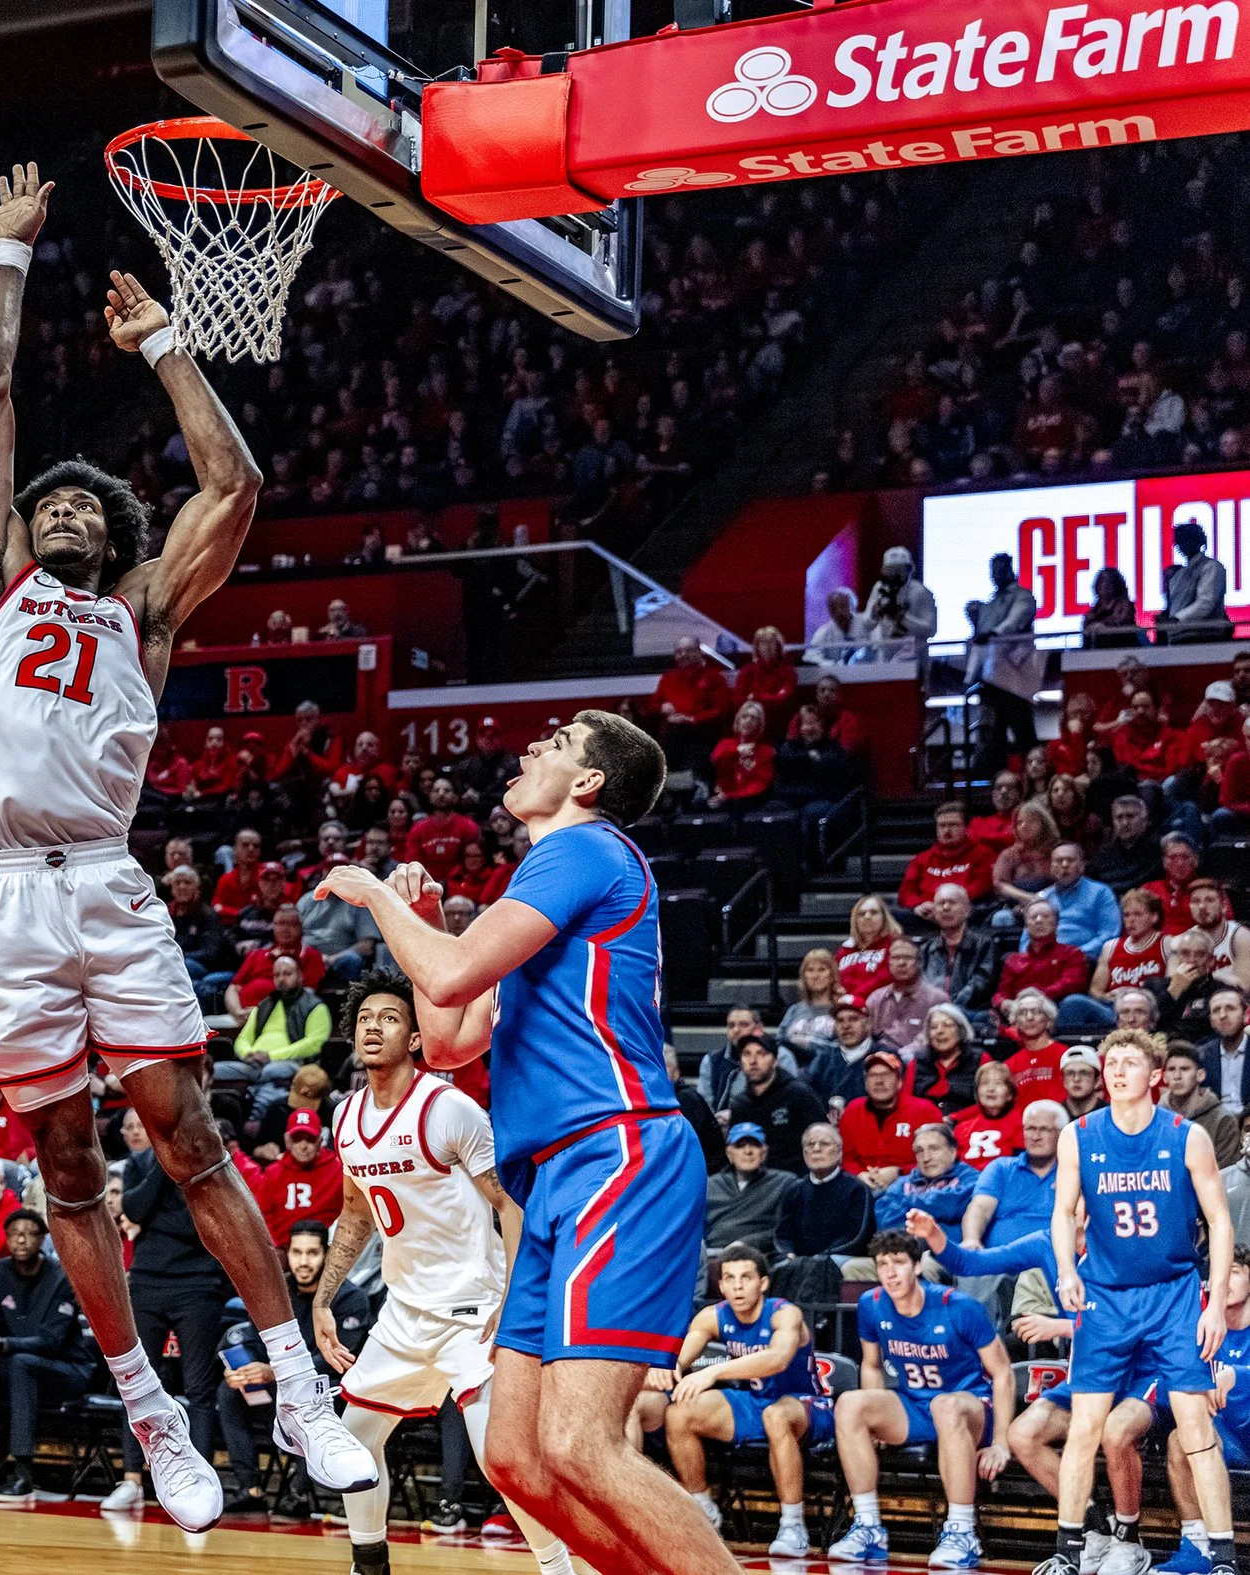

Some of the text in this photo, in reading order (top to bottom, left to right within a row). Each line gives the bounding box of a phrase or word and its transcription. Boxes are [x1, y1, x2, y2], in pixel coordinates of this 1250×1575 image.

[826, 0, 1240, 109] State Farm
[738, 115, 1157, 180] State Farm
[1018, 512, 1127, 620] GET
[15, 622, 98, 706] 21
[223, 666, 270, 713] R
[402, 718, 470, 755] 113
[1111, 960, 1160, 984] Knights
[896, 1123, 911, 1137] R
[964, 1130, 1001, 1159] R
[285, 1183, 312, 1210] R
[1097, 1170, 1171, 1195] AMERICAN
[369, 1186, 405, 1238] 0
[1114, 1200, 1160, 1239] 33
[888, 1339, 949, 1360] AMERICAN
[904, 1362, 944, 1389] 35
[1024, 1365, 1069, 1403] R
